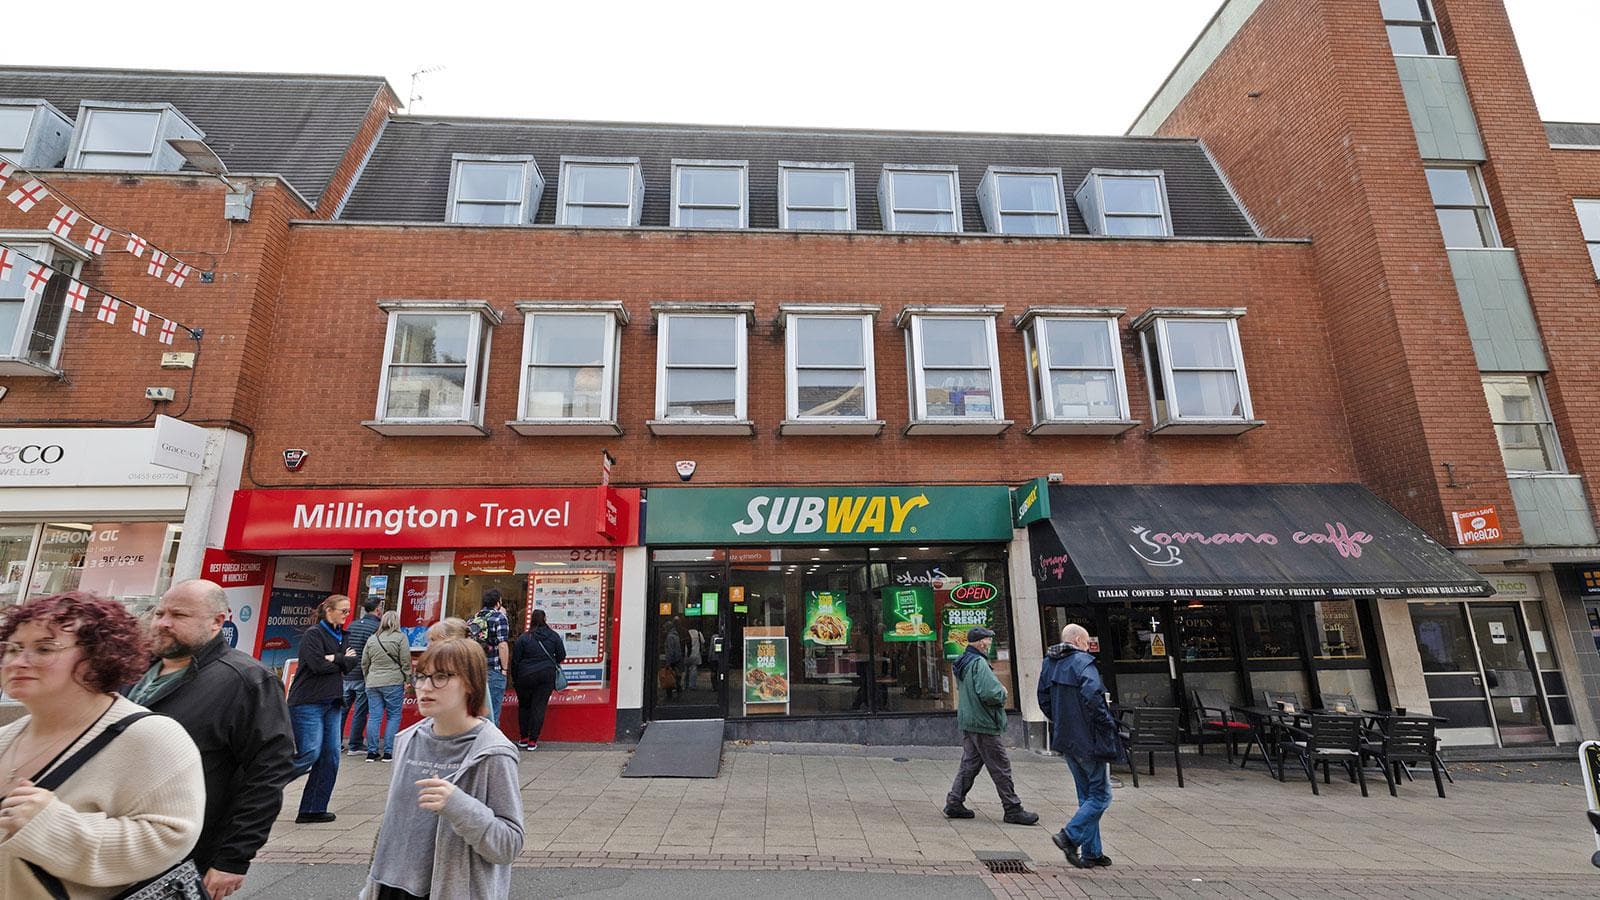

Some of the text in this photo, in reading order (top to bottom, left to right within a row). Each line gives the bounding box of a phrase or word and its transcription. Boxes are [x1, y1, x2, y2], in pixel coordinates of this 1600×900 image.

[1018, 485, 1038, 520] SUBWAY
[293, 501, 570, 535] Millington Travel
[732, 493, 930, 536] SUBWAY
[1293, 522, 1373, 558] caffe
[1464, 528, 1499, 542] mealzo
[210, 563, 261, 572] BEST FOREIGN EXCHANGE
[222, 573, 248, 582] IN HINCKLEY
[956, 587, 991, 599] OPEN
[1098, 590, 1129, 598] ITALIAN
[1132, 589, 1164, 597] COFFEES
[1170, 589, 1193, 597] EARLY
[1228, 588, 1254, 596] PANINI
[1260, 588, 1284, 596] PASTA
[1288, 588, 1326, 596] FRITTATA
[1380, 587, 1400, 595] PIZZA
[1440, 586, 1484, 594] BREAKFAST
[281, 606, 312, 614] HINCKLEY
[267, 616, 298, 625] BOOKING
[949, 617, 987, 625] FRESH?
[1186, 618, 1213, 627] OPEN
